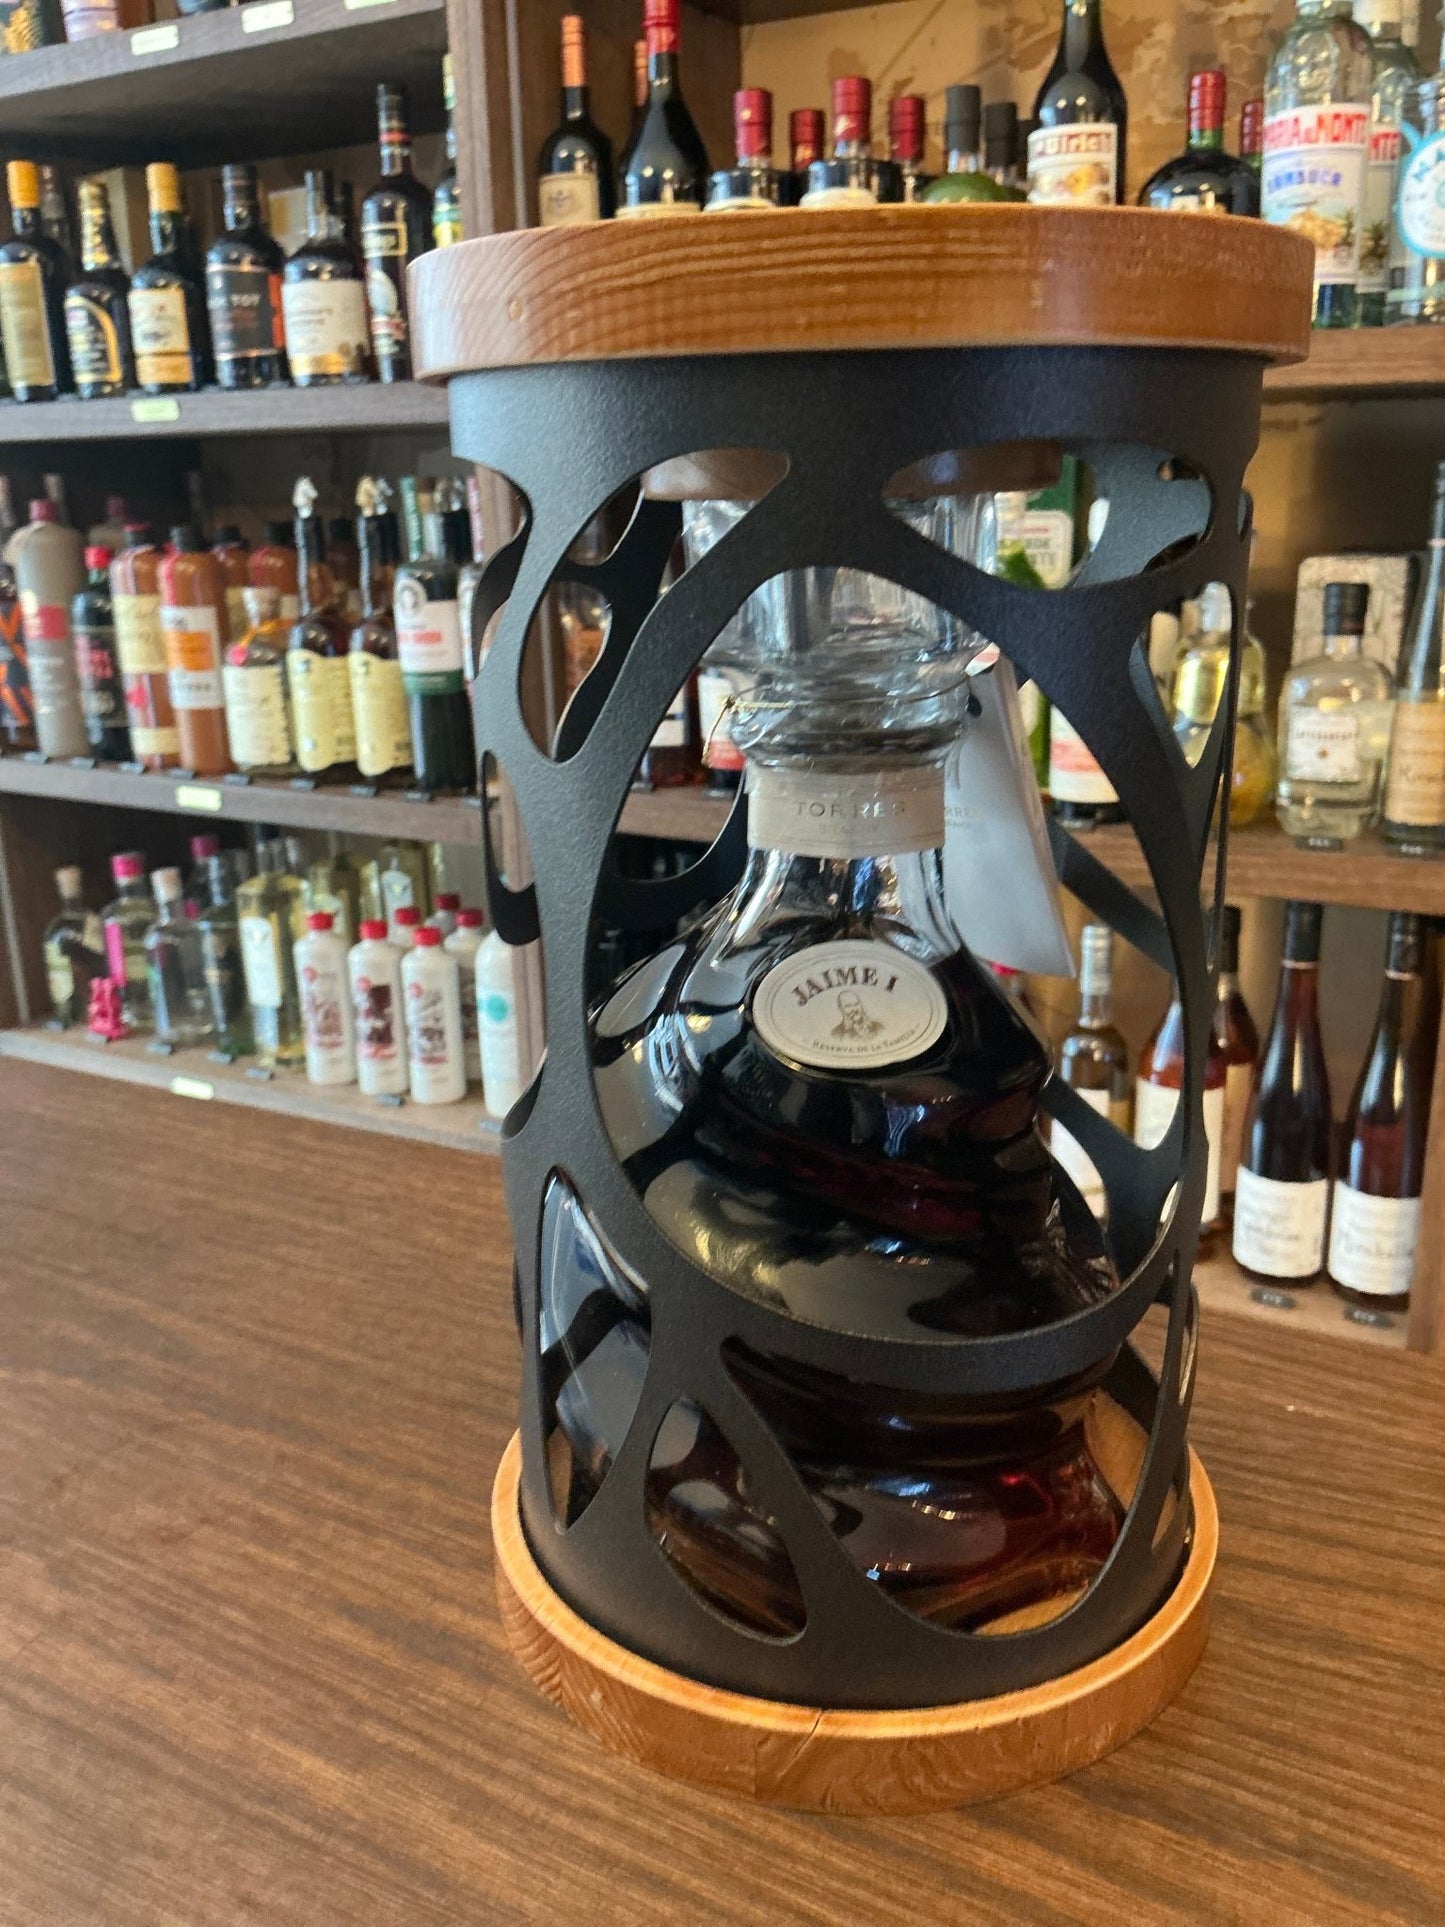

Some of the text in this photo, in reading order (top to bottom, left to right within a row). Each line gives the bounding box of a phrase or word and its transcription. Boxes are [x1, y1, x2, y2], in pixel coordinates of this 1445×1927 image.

[793, 801, 905, 819] TORRES
[791, 966, 898, 1006] JAIME I
